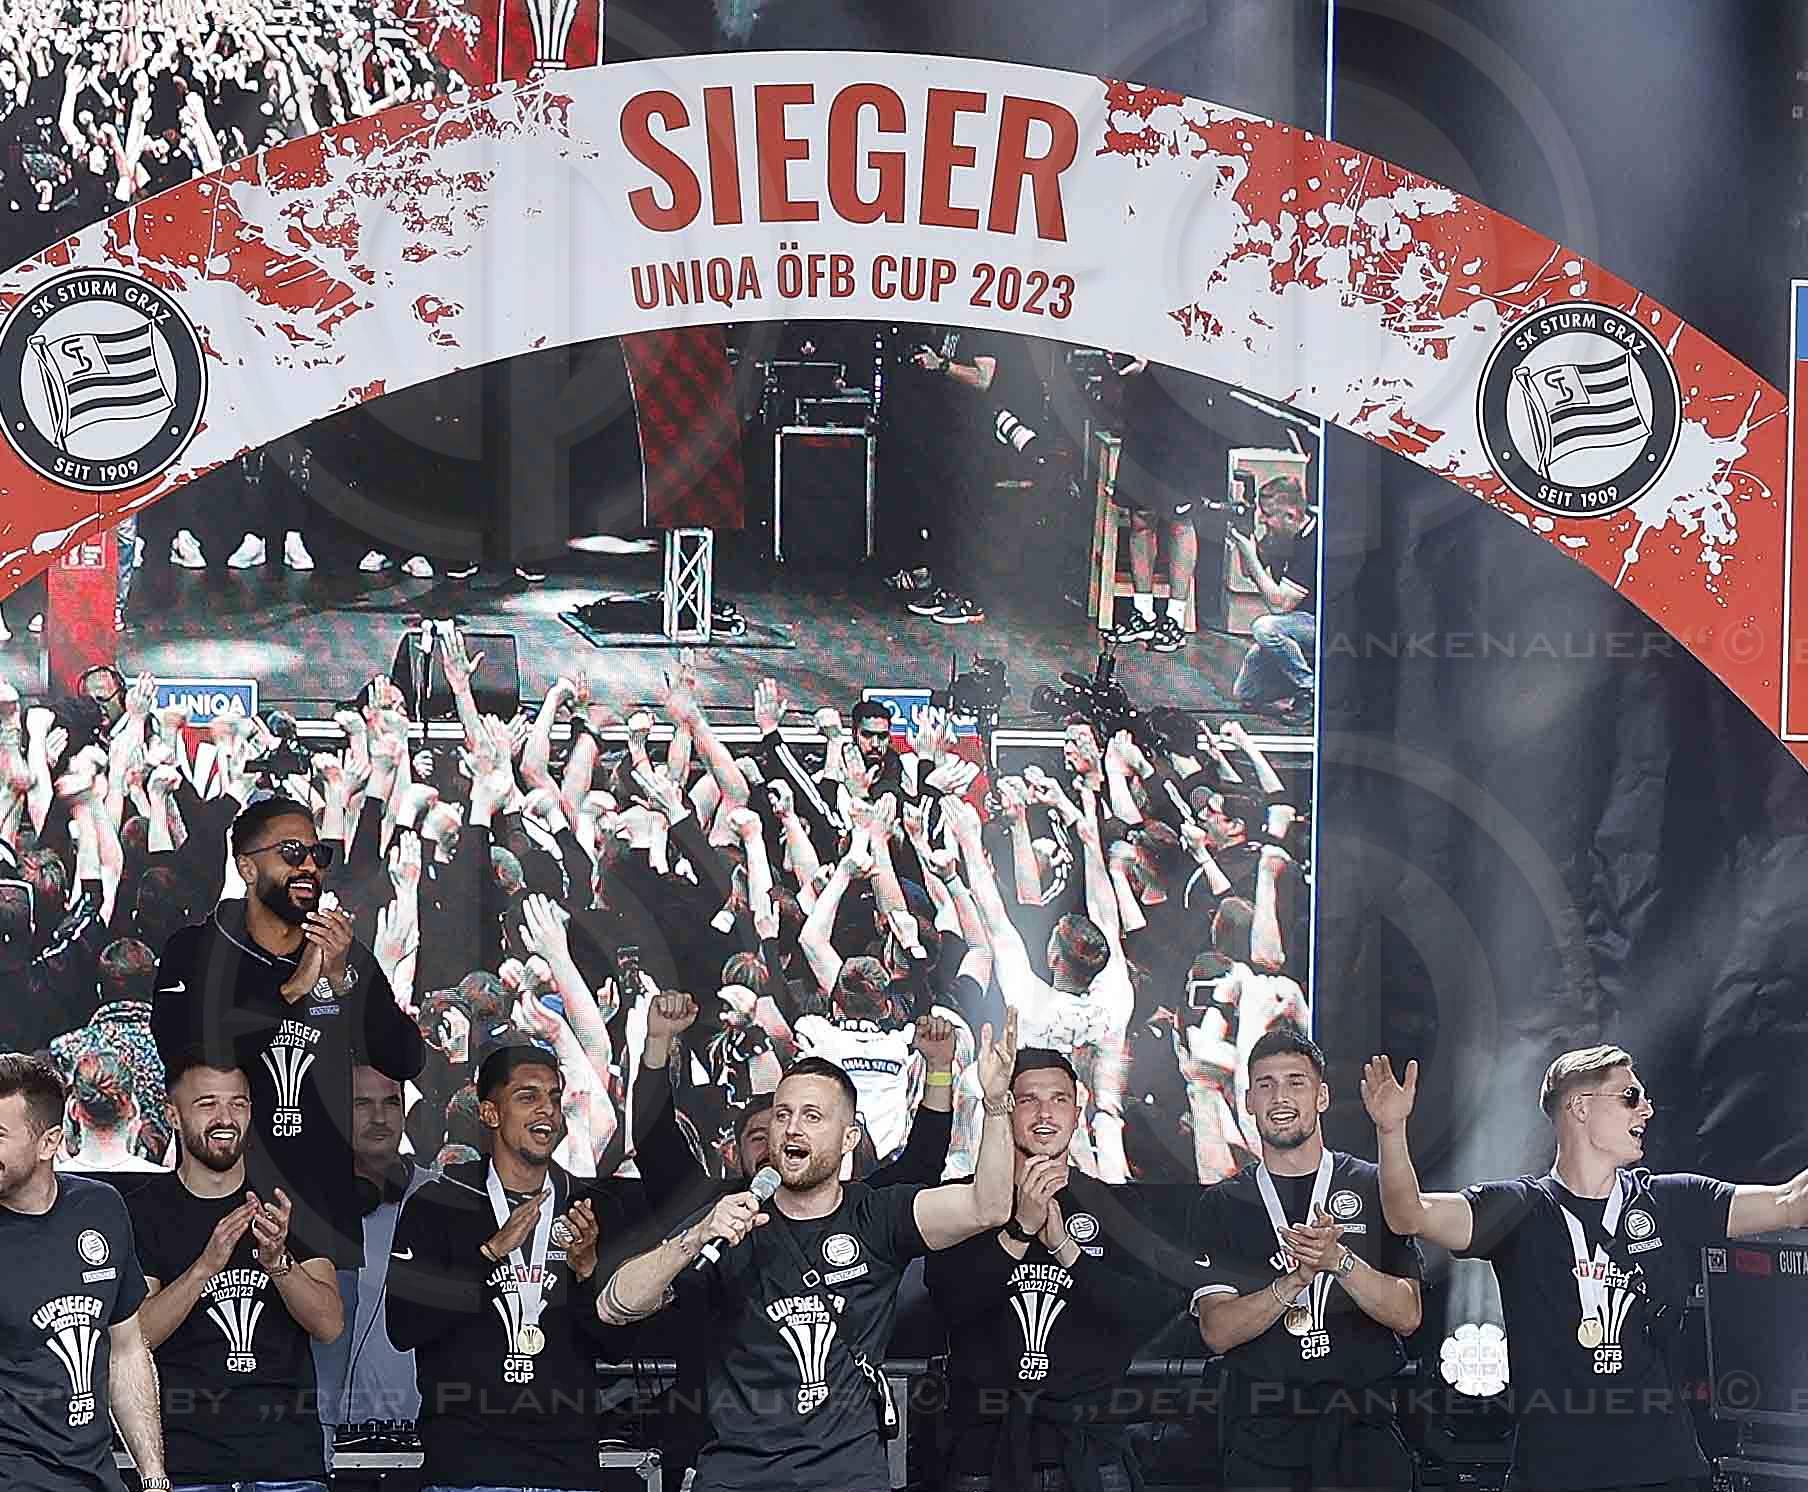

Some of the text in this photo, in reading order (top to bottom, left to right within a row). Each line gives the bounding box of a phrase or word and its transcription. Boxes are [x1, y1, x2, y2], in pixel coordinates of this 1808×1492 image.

[620, 82, 1080, 242] SIEGER
[632, 243, 1077, 320] UNIQA ÖFB CUP 2023
[31, 281, 172, 326] SK STURM GRAZ
[1515, 313, 1647, 356] SK STURM GRAZ
[53, 457, 139, 481] SEIT 1909
[1537, 485, 1617, 507] SEIT 1909
[273, 1125, 302, 1136] CUP
[32, 1295, 103, 1329] CUPSIEGER
[1302, 1346, 1330, 1359] CUP
[504, 1372, 534, 1383] CUP
[1018, 1369, 1047, 1381] CUP
[1594, 1362, 1622, 1373] CUP
[69, 1412, 94, 1426] CUP
